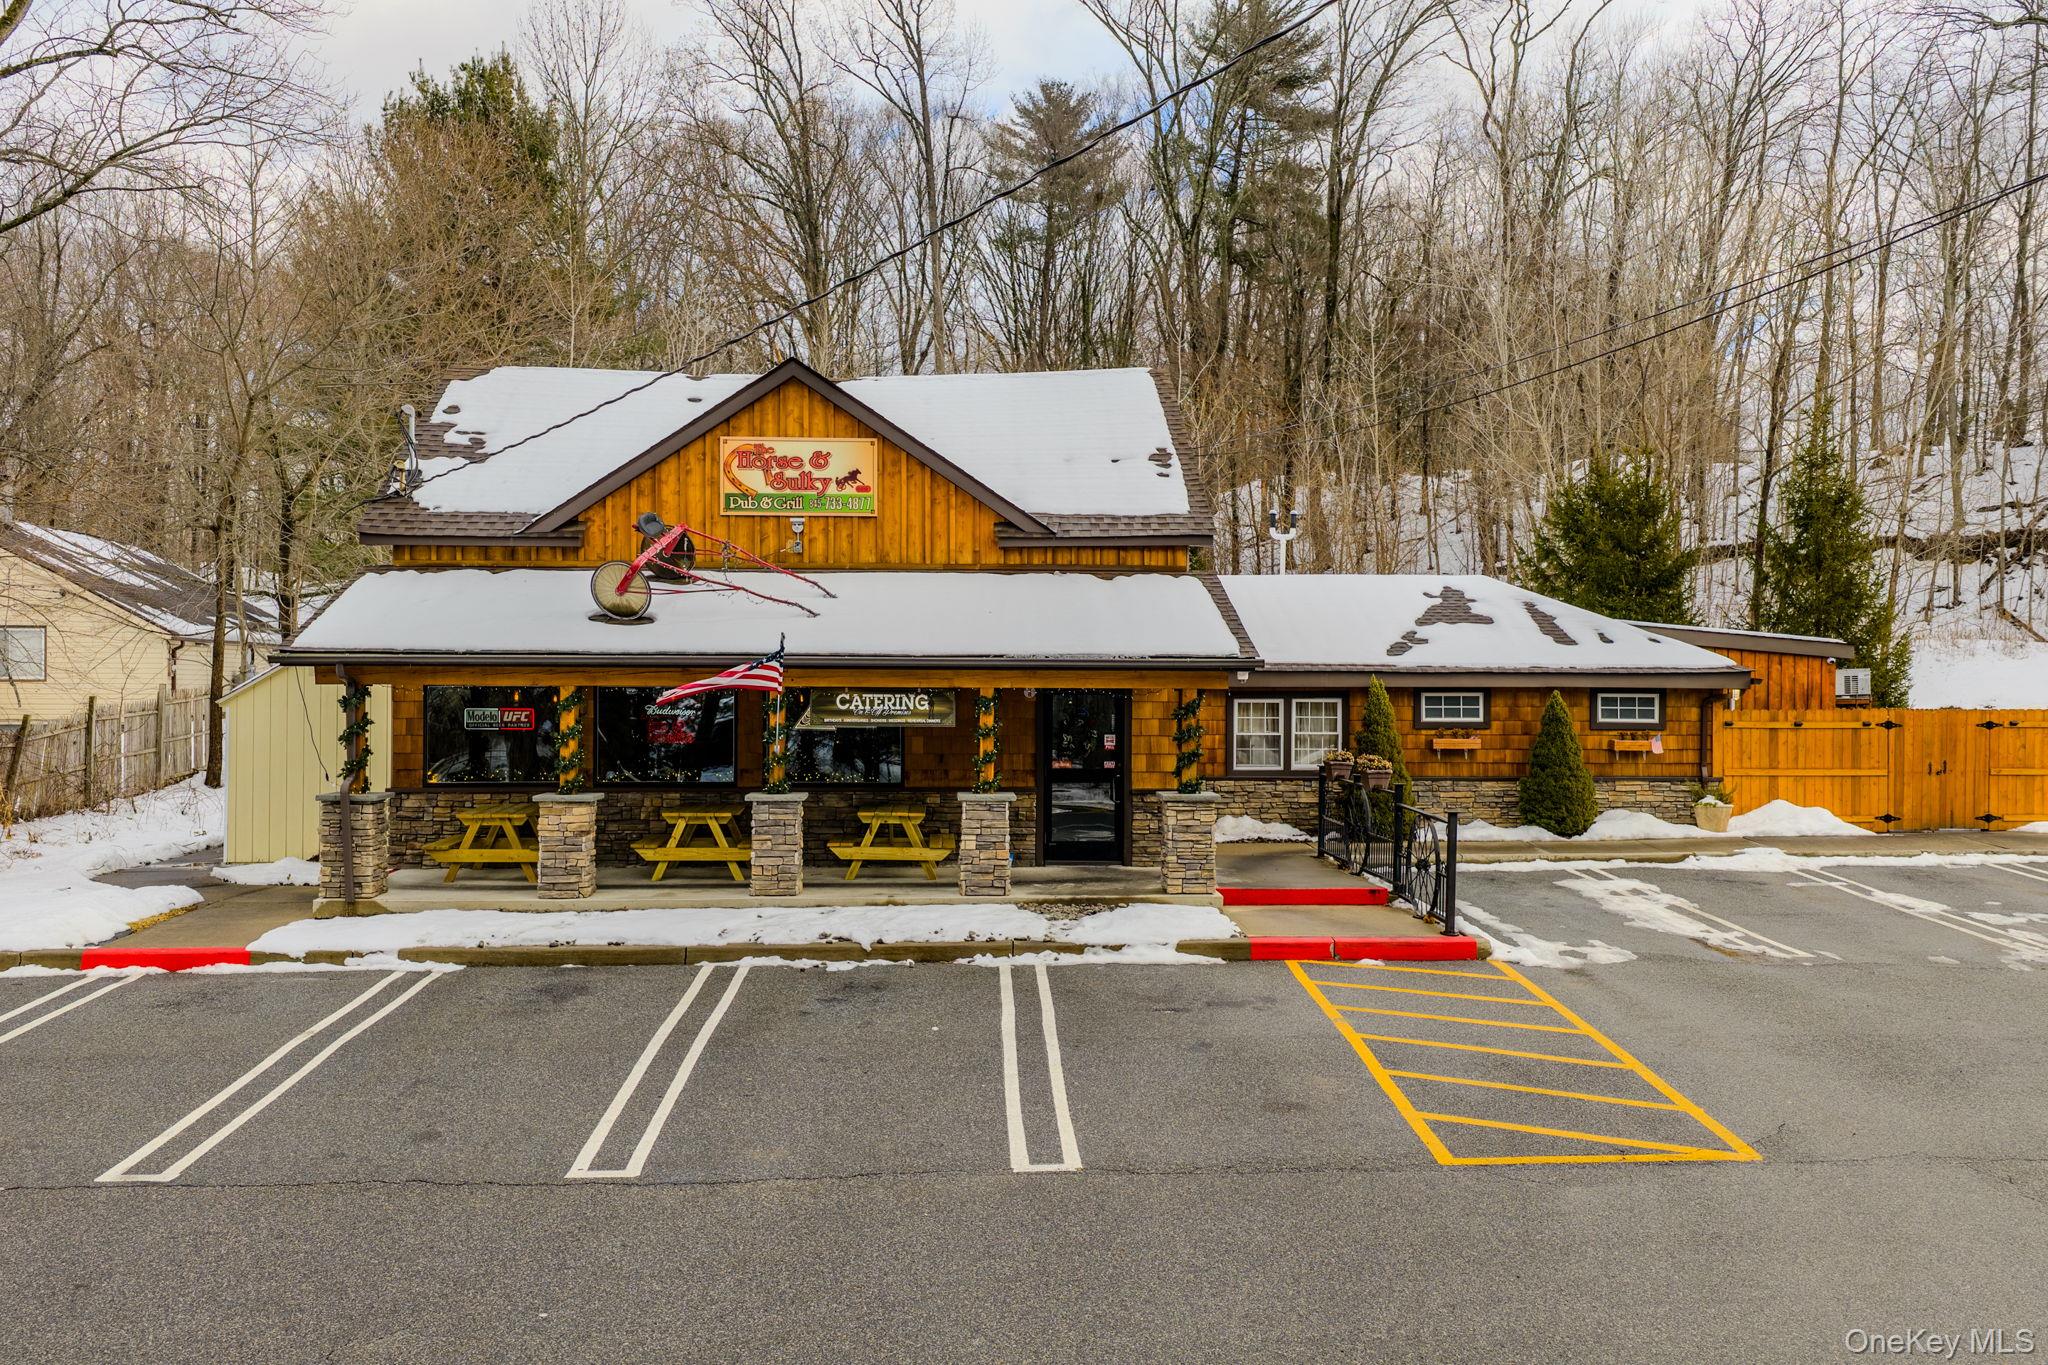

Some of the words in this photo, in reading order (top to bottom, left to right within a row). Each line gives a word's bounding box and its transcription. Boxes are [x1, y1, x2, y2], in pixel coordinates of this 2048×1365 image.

[753, 443, 775, 455] The
[736, 450, 804, 470] Horse
[809, 450, 832, 470] &
[769, 470, 833, 497] Sulky
[729, 496, 758, 509] Pub
[760, 496, 773, 509] &
[774, 496, 804, 509] Grill
[835, 693, 930, 711] CATERING
[466, 711, 498, 721] Modelo
[502, 711, 530, 722] UFC
[644, 704, 697, 716] Budweiser
